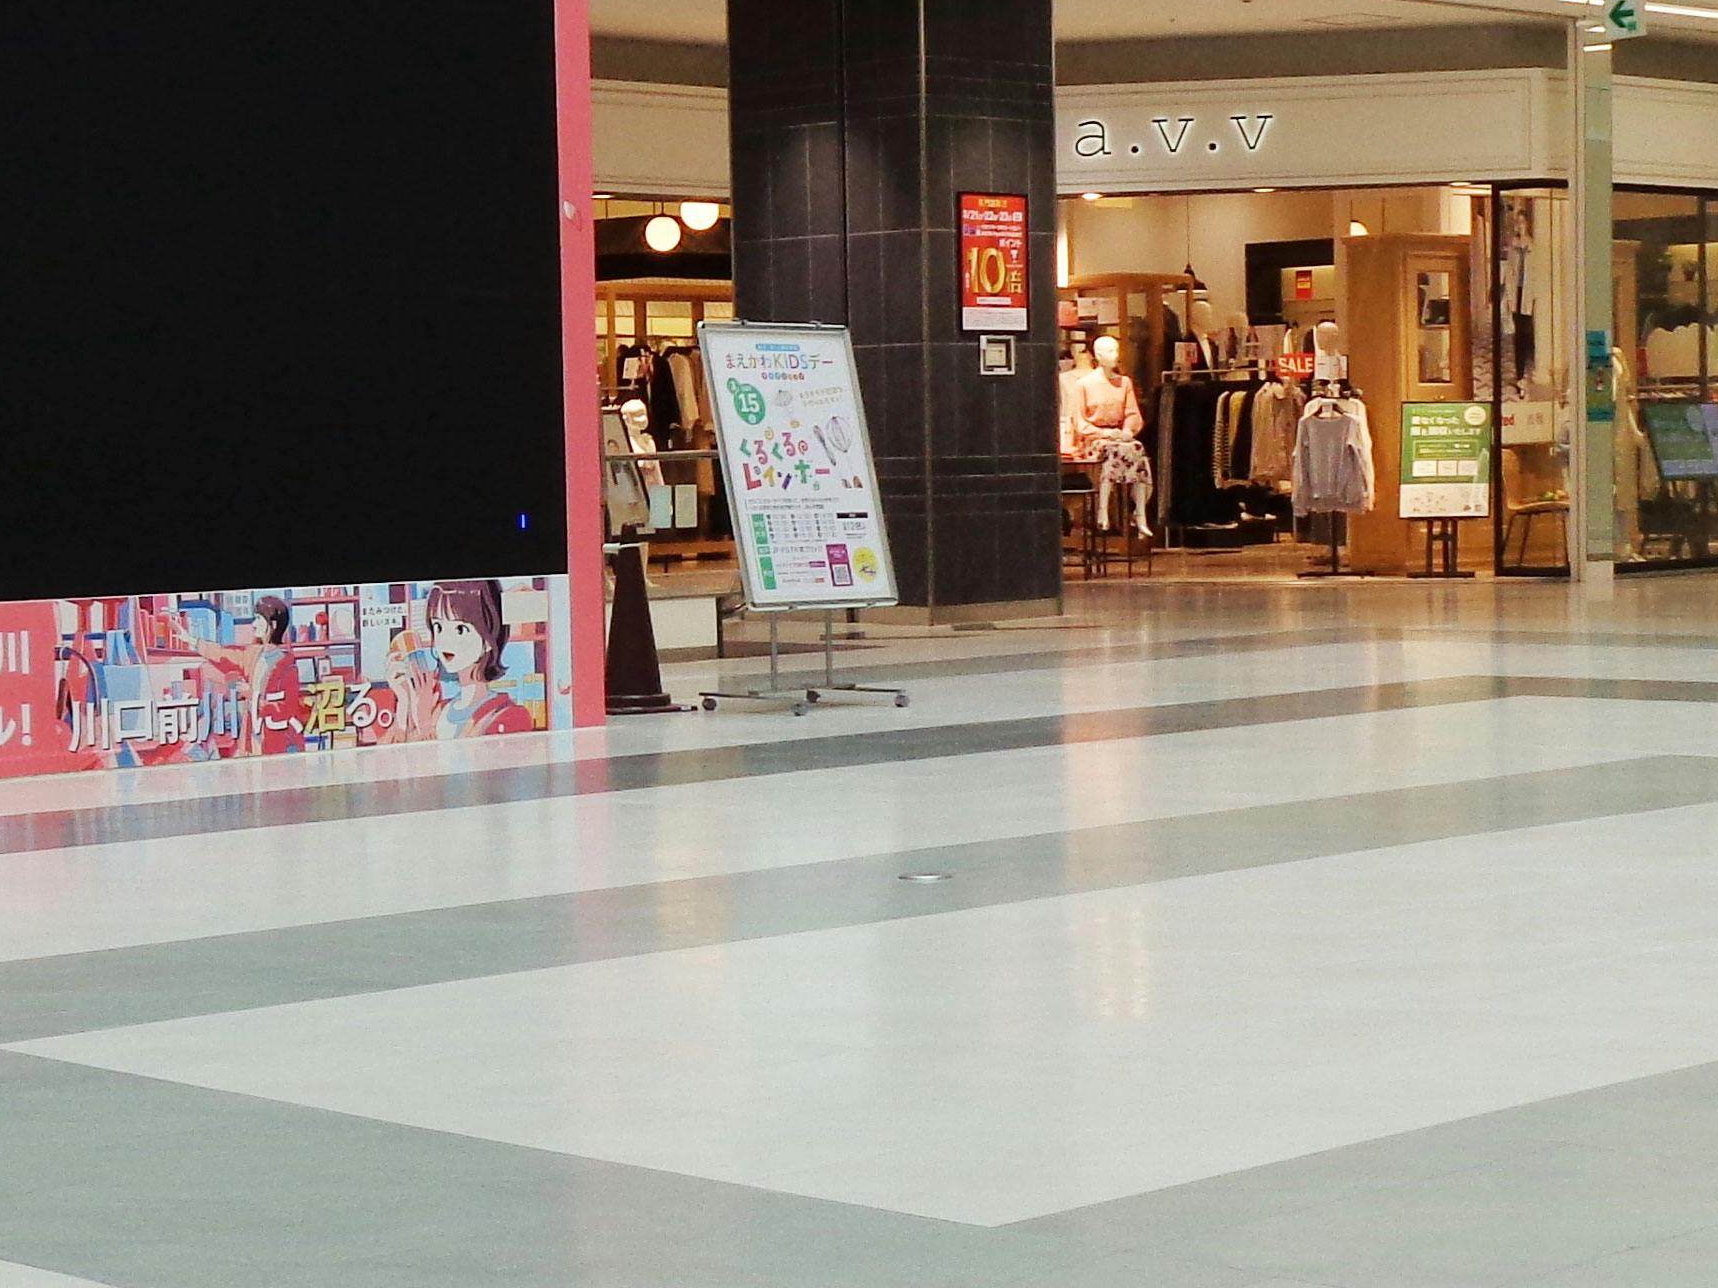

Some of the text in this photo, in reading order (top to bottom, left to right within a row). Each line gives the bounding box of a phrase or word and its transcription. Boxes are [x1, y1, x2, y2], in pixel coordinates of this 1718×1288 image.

[1074, 113, 1274, 158] a.v.v
[1277, 357, 1314, 373] SALE
[738, 393, 760, 414] 15
[68, 680, 395, 753] 川口前川に、沼る。
